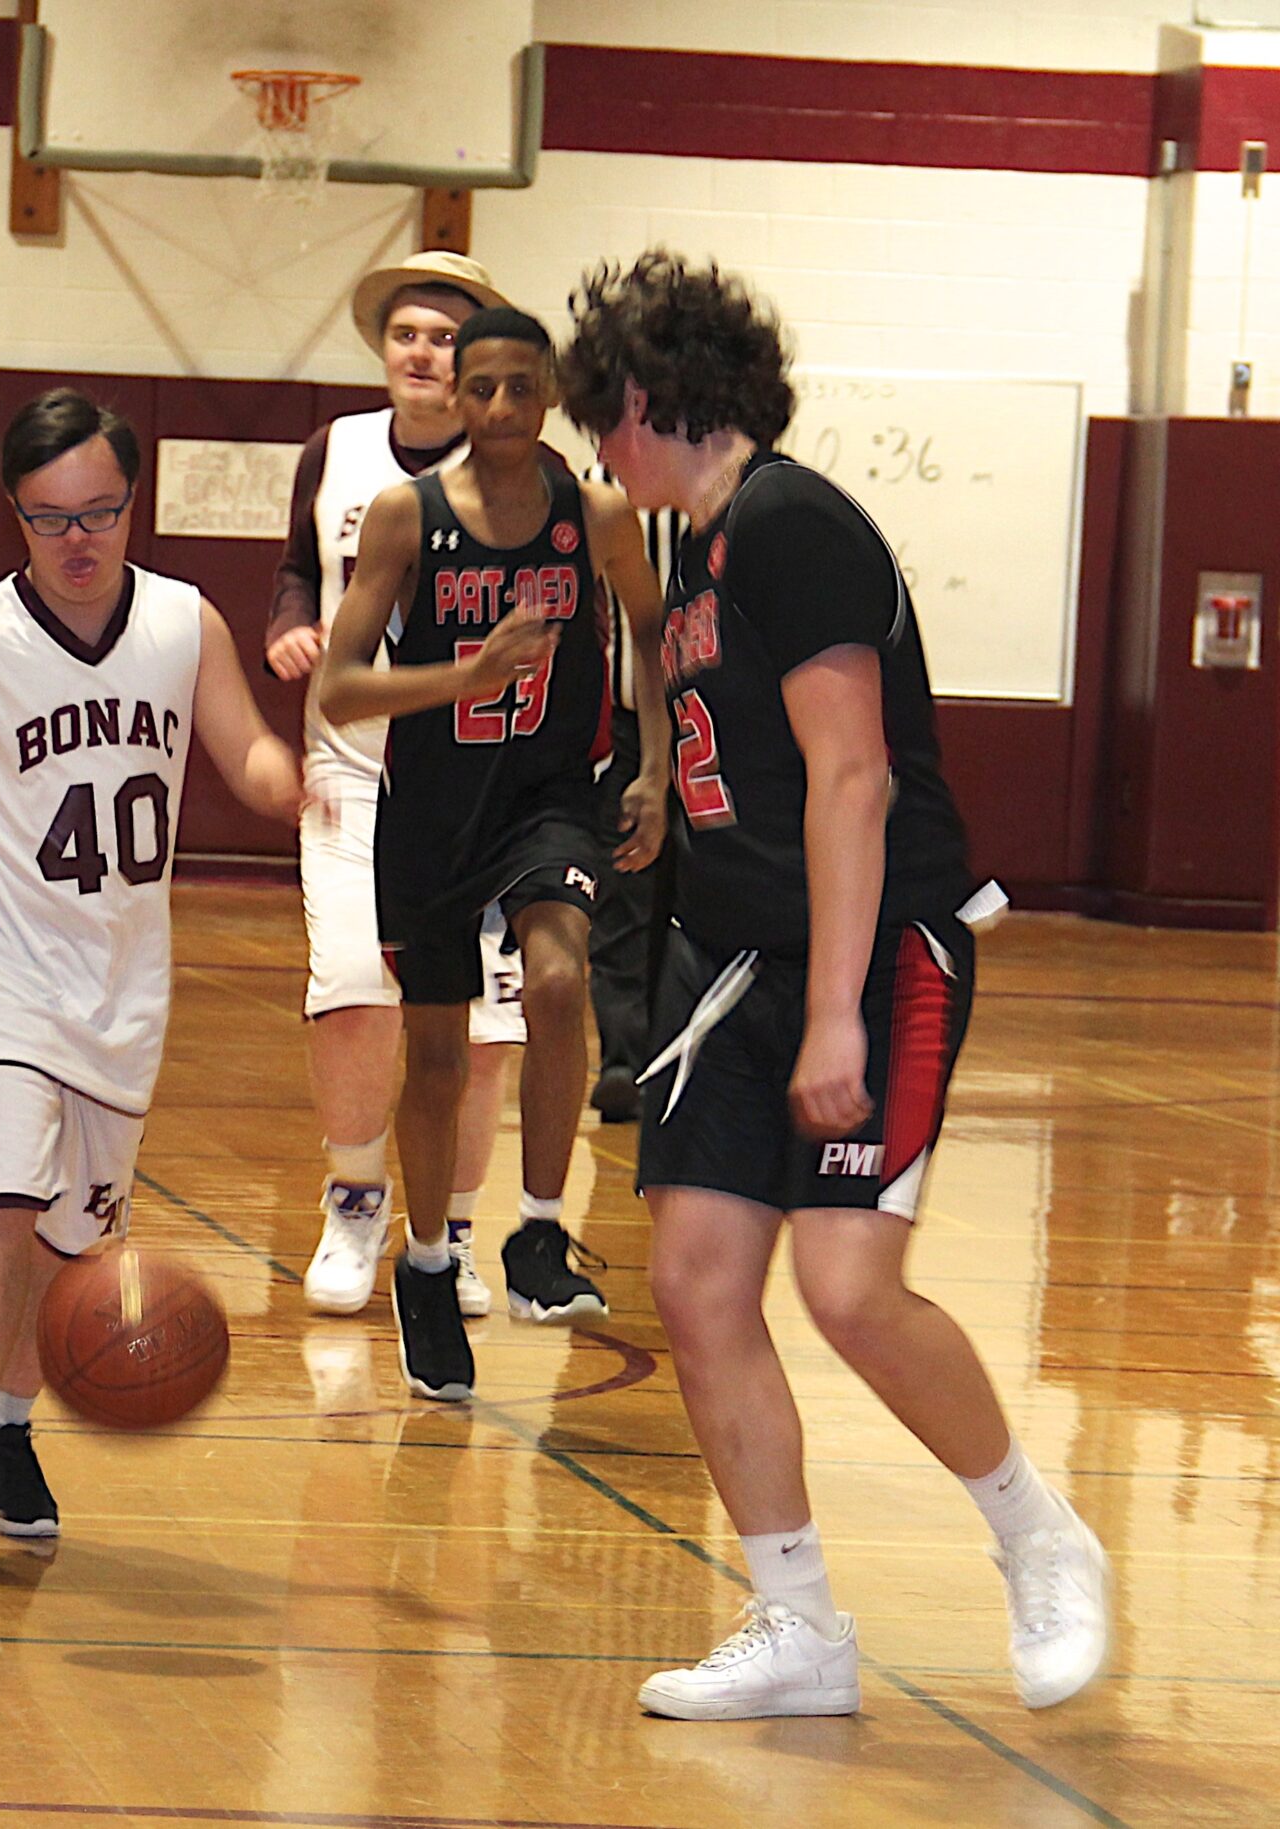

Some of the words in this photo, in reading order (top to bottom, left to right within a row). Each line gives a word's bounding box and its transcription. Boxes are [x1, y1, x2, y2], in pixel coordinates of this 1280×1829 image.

[434, 565, 578, 625] PAT-MED
[453, 638, 555, 744] 23
[16, 698, 179, 774] BONAC
[35, 772, 169, 895] 40
[818, 1142, 886, 1176] PM
